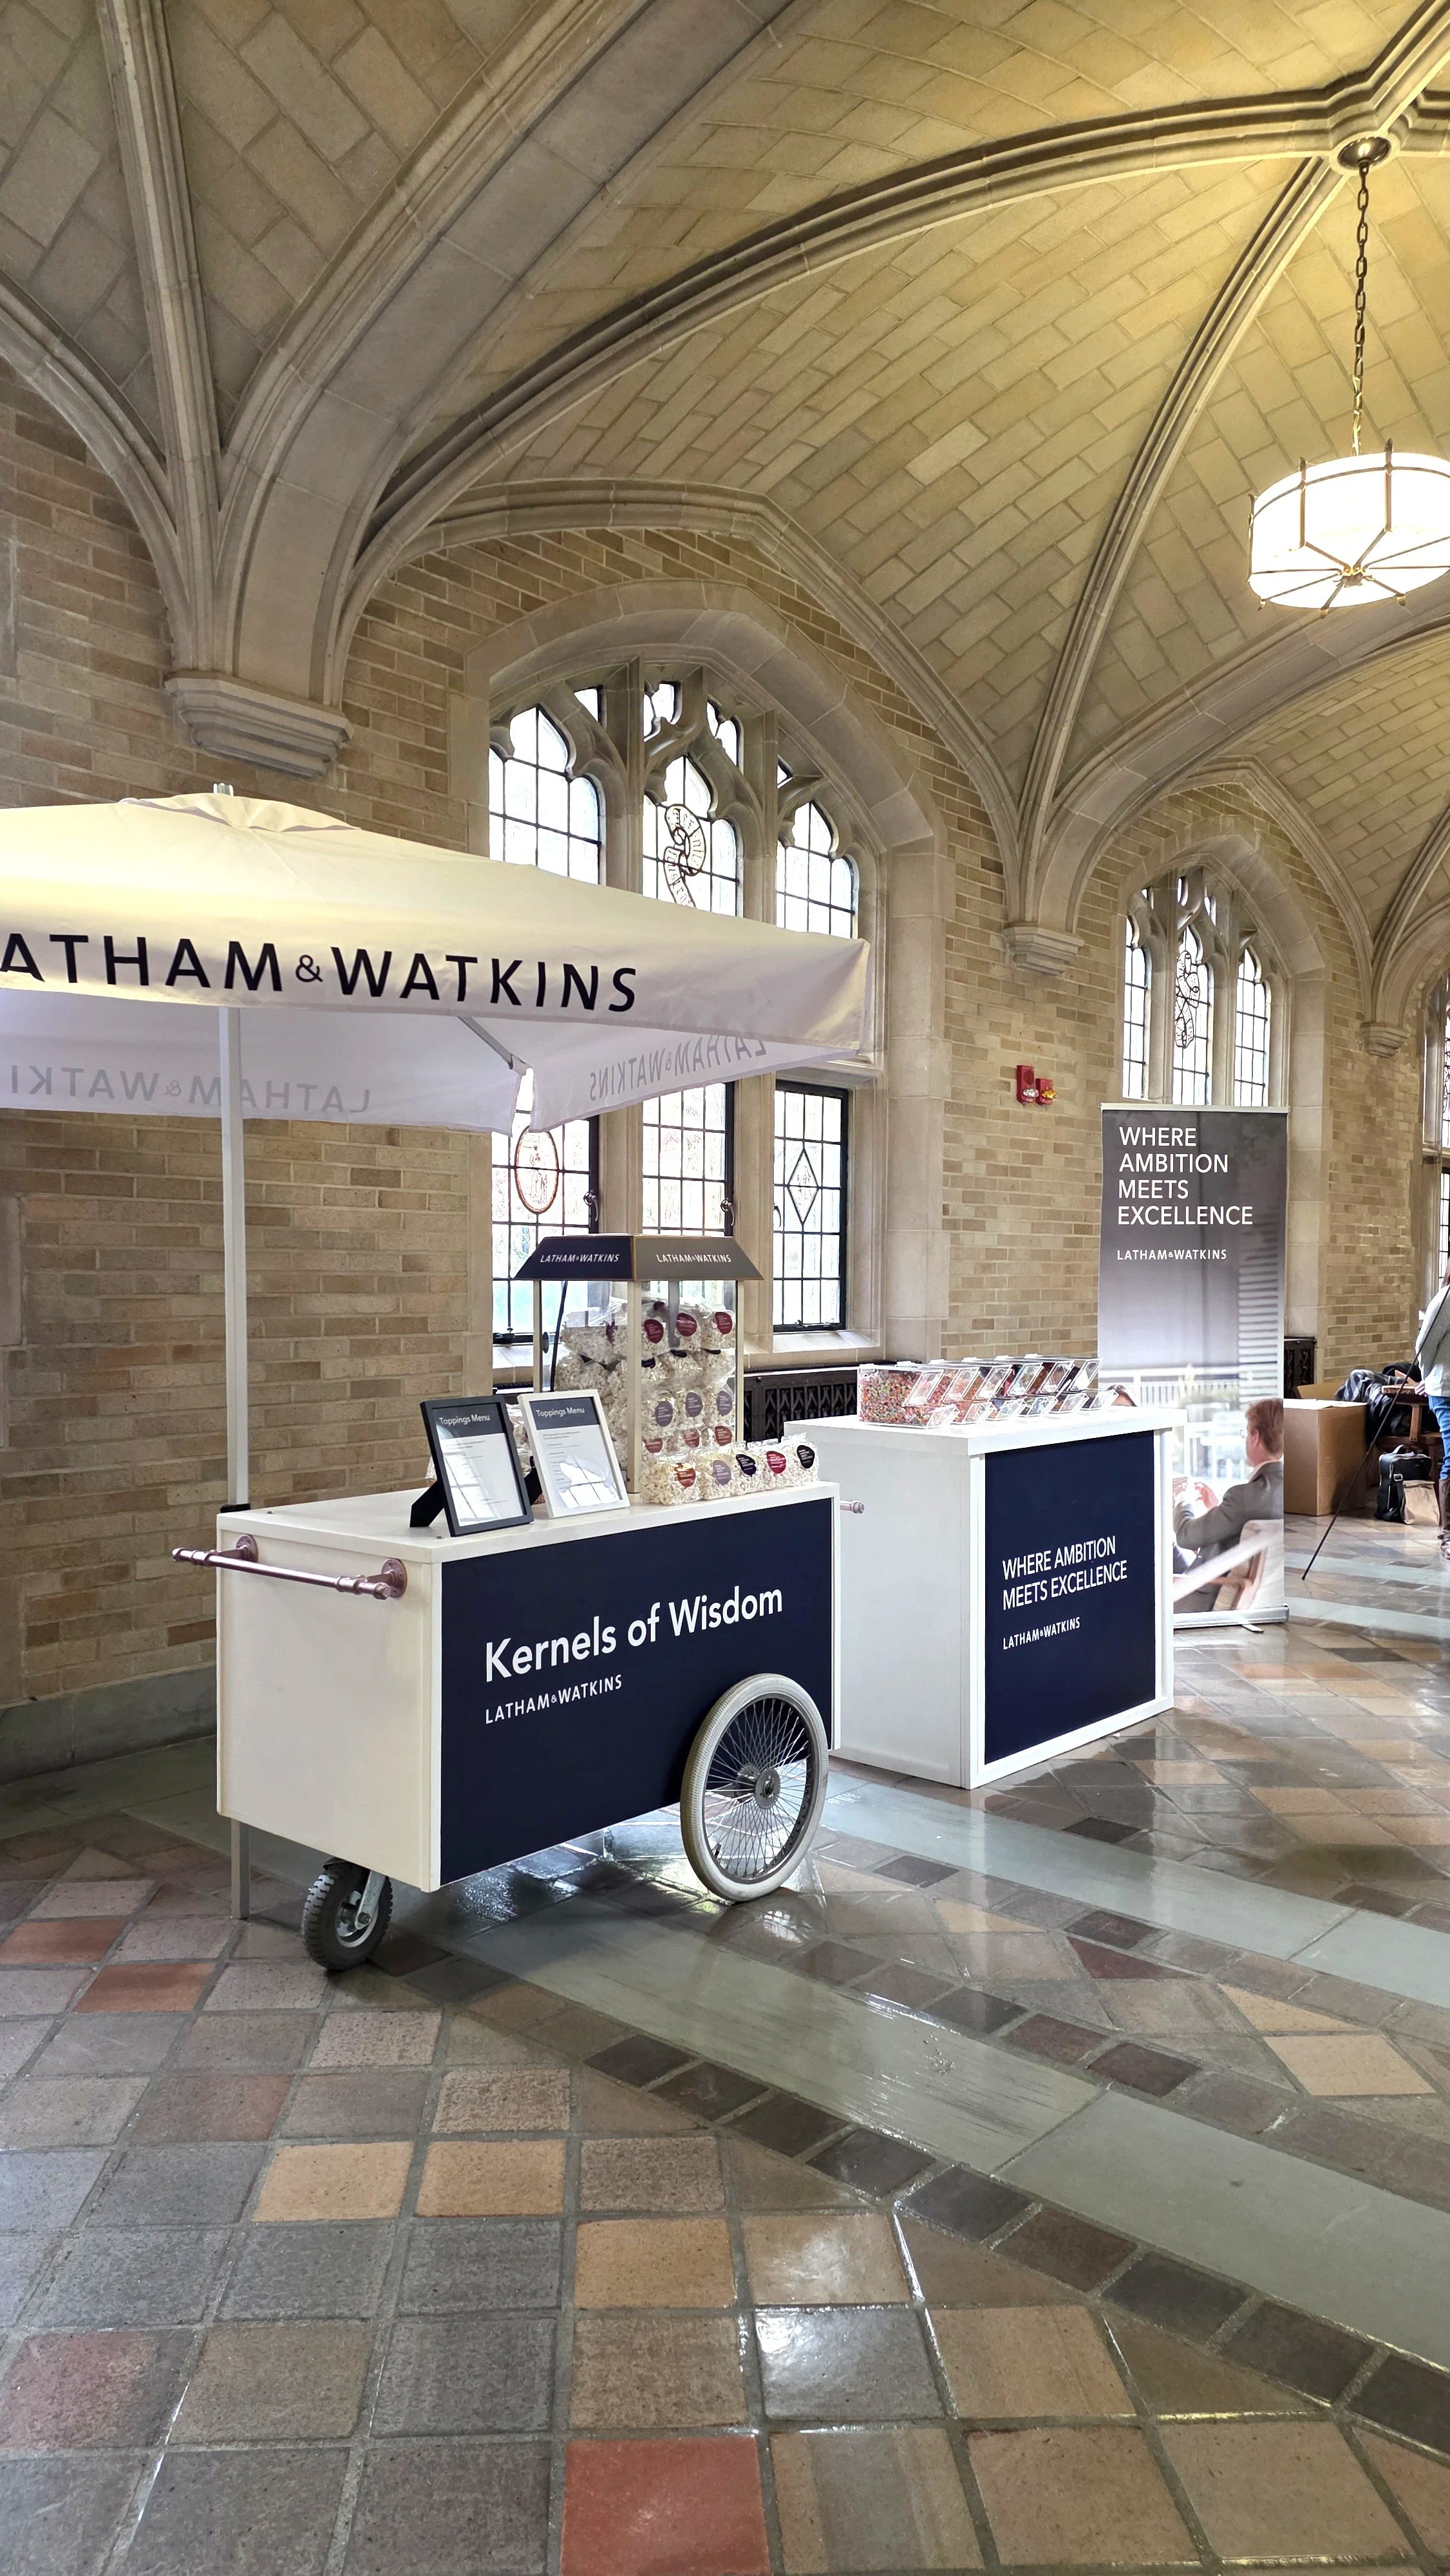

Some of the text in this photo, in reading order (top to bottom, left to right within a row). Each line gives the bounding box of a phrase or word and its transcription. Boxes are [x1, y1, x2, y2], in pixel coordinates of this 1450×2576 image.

[0, 933, 637, 1012] ATHAM&WATKINS
[1119, 1127, 1196, 1146] WHERE
[1119, 1153, 1228, 1173] AMBITION
[1119, 1179, 1189, 1199] MEETS
[1118, 1206, 1253, 1225] EXCELLENCE
[540, 1254, 620, 1264] LATHAM&WATKINS
[656, 1254, 732, 1264] LATHAM&WATKINS
[1117, 1249, 1227, 1260] LATHAM&WATKINS
[438, 1416, 471, 1426] Toppings
[535, 1408, 566, 1418] Toppings
[1002, 1535, 1116, 1580] WHERE AMBITION
[1003, 1560, 1127, 1610] MEETS EXCELLENCE
[485, 1586, 783, 1682] Kernels of Wisdom
[1003, 1616, 1080, 1650] LATHAM&WATKINS
[485, 1674, 622, 1725] LATHAM&WATKINS
